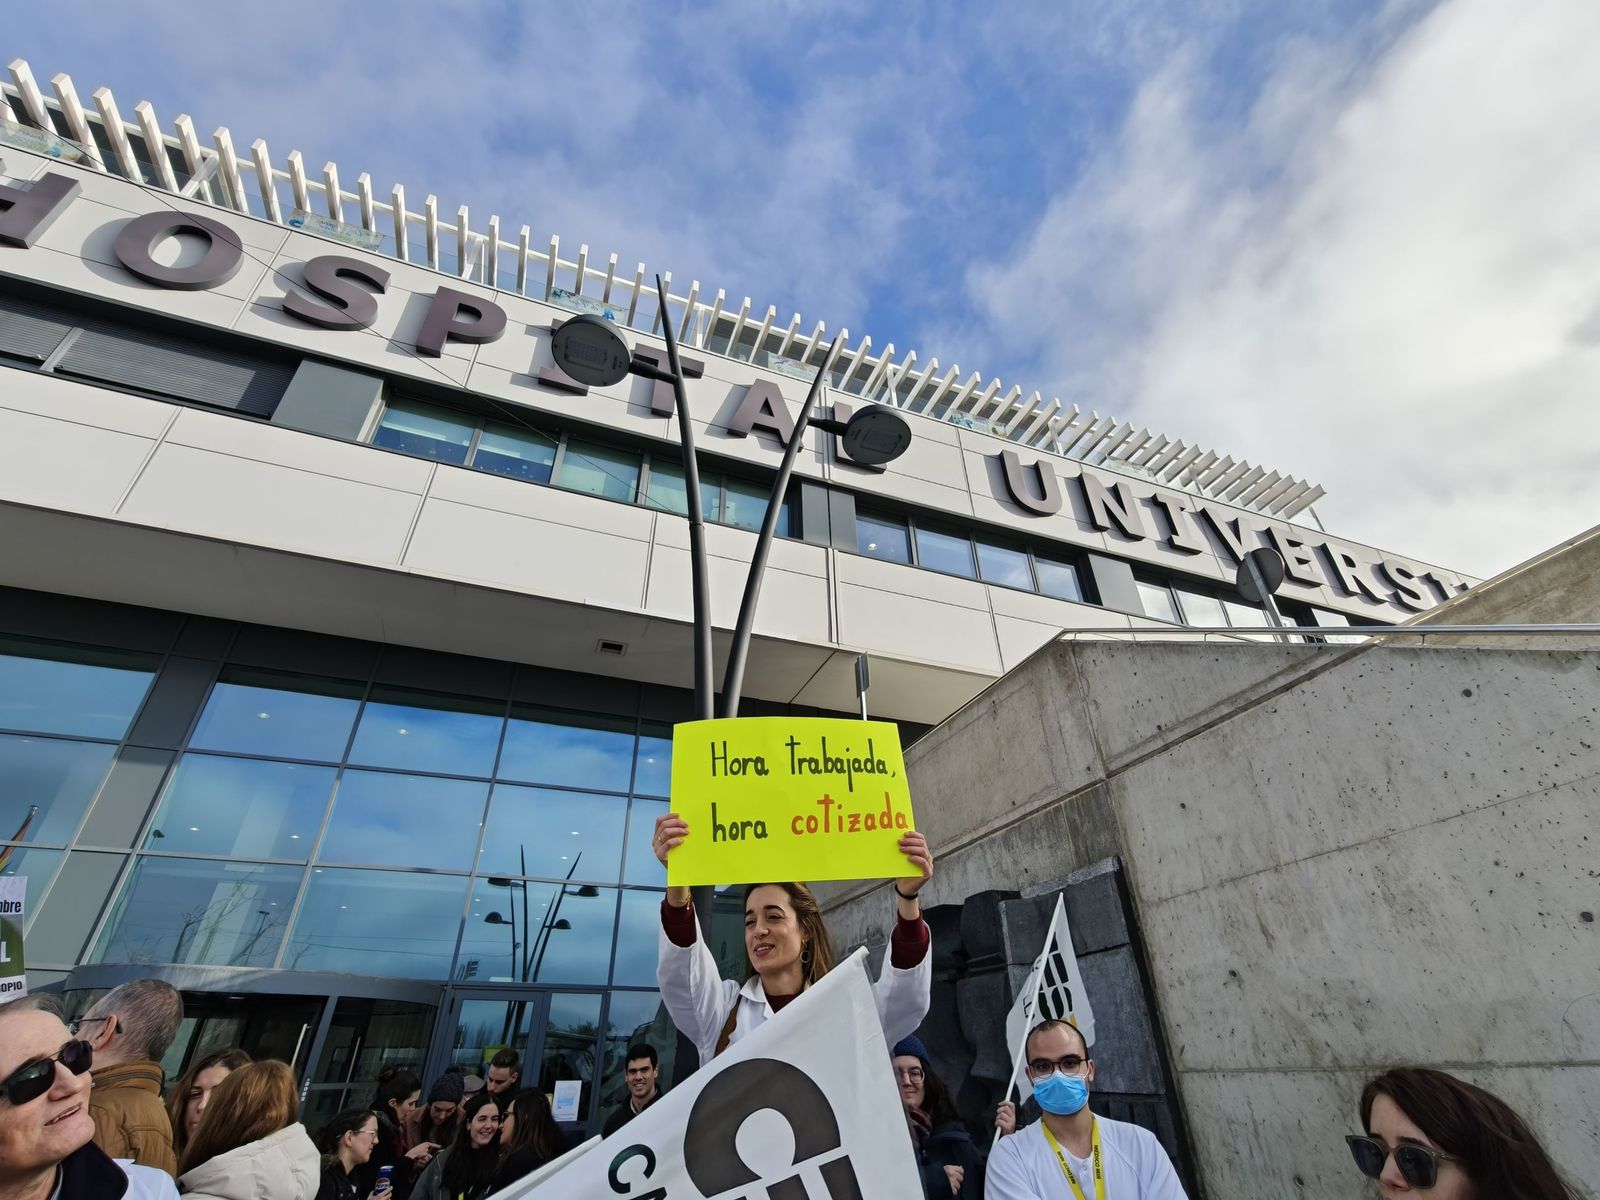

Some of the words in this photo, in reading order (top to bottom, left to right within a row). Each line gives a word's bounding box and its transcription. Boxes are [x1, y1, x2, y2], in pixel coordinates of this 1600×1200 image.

[1000, 449, 1469, 613] UNIVERSI
[711, 740, 769, 777] Hora
[785, 735, 896, 792] trabajada,
[711, 802, 768, 842] hora
[791, 791, 908, 835] cotizada
